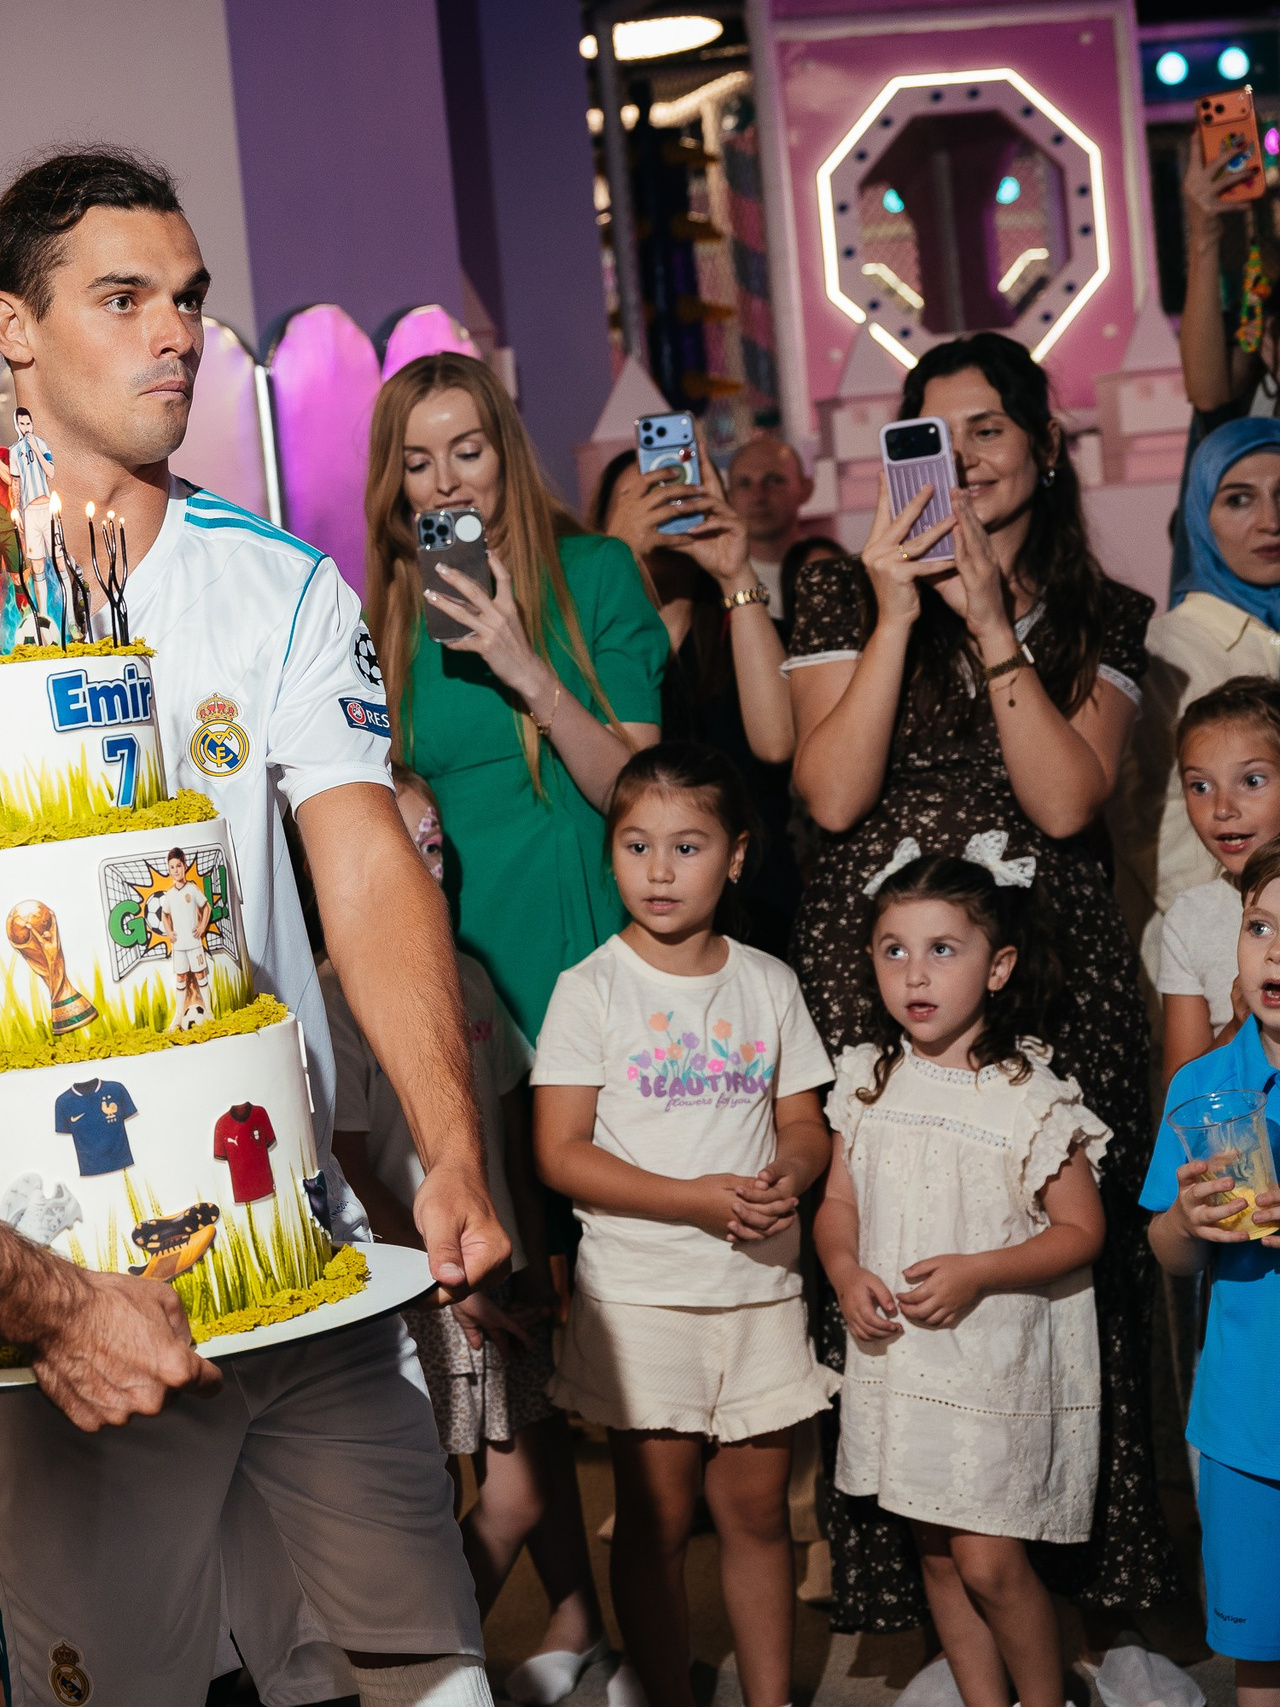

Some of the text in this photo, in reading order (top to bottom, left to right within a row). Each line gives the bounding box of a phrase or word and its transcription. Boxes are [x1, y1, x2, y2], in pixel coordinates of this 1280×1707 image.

[47, 663, 152, 732] Emir
[366, 709, 390, 728] RES
[102, 733, 139, 809] 7
[730, 1098, 752, 1109] you
